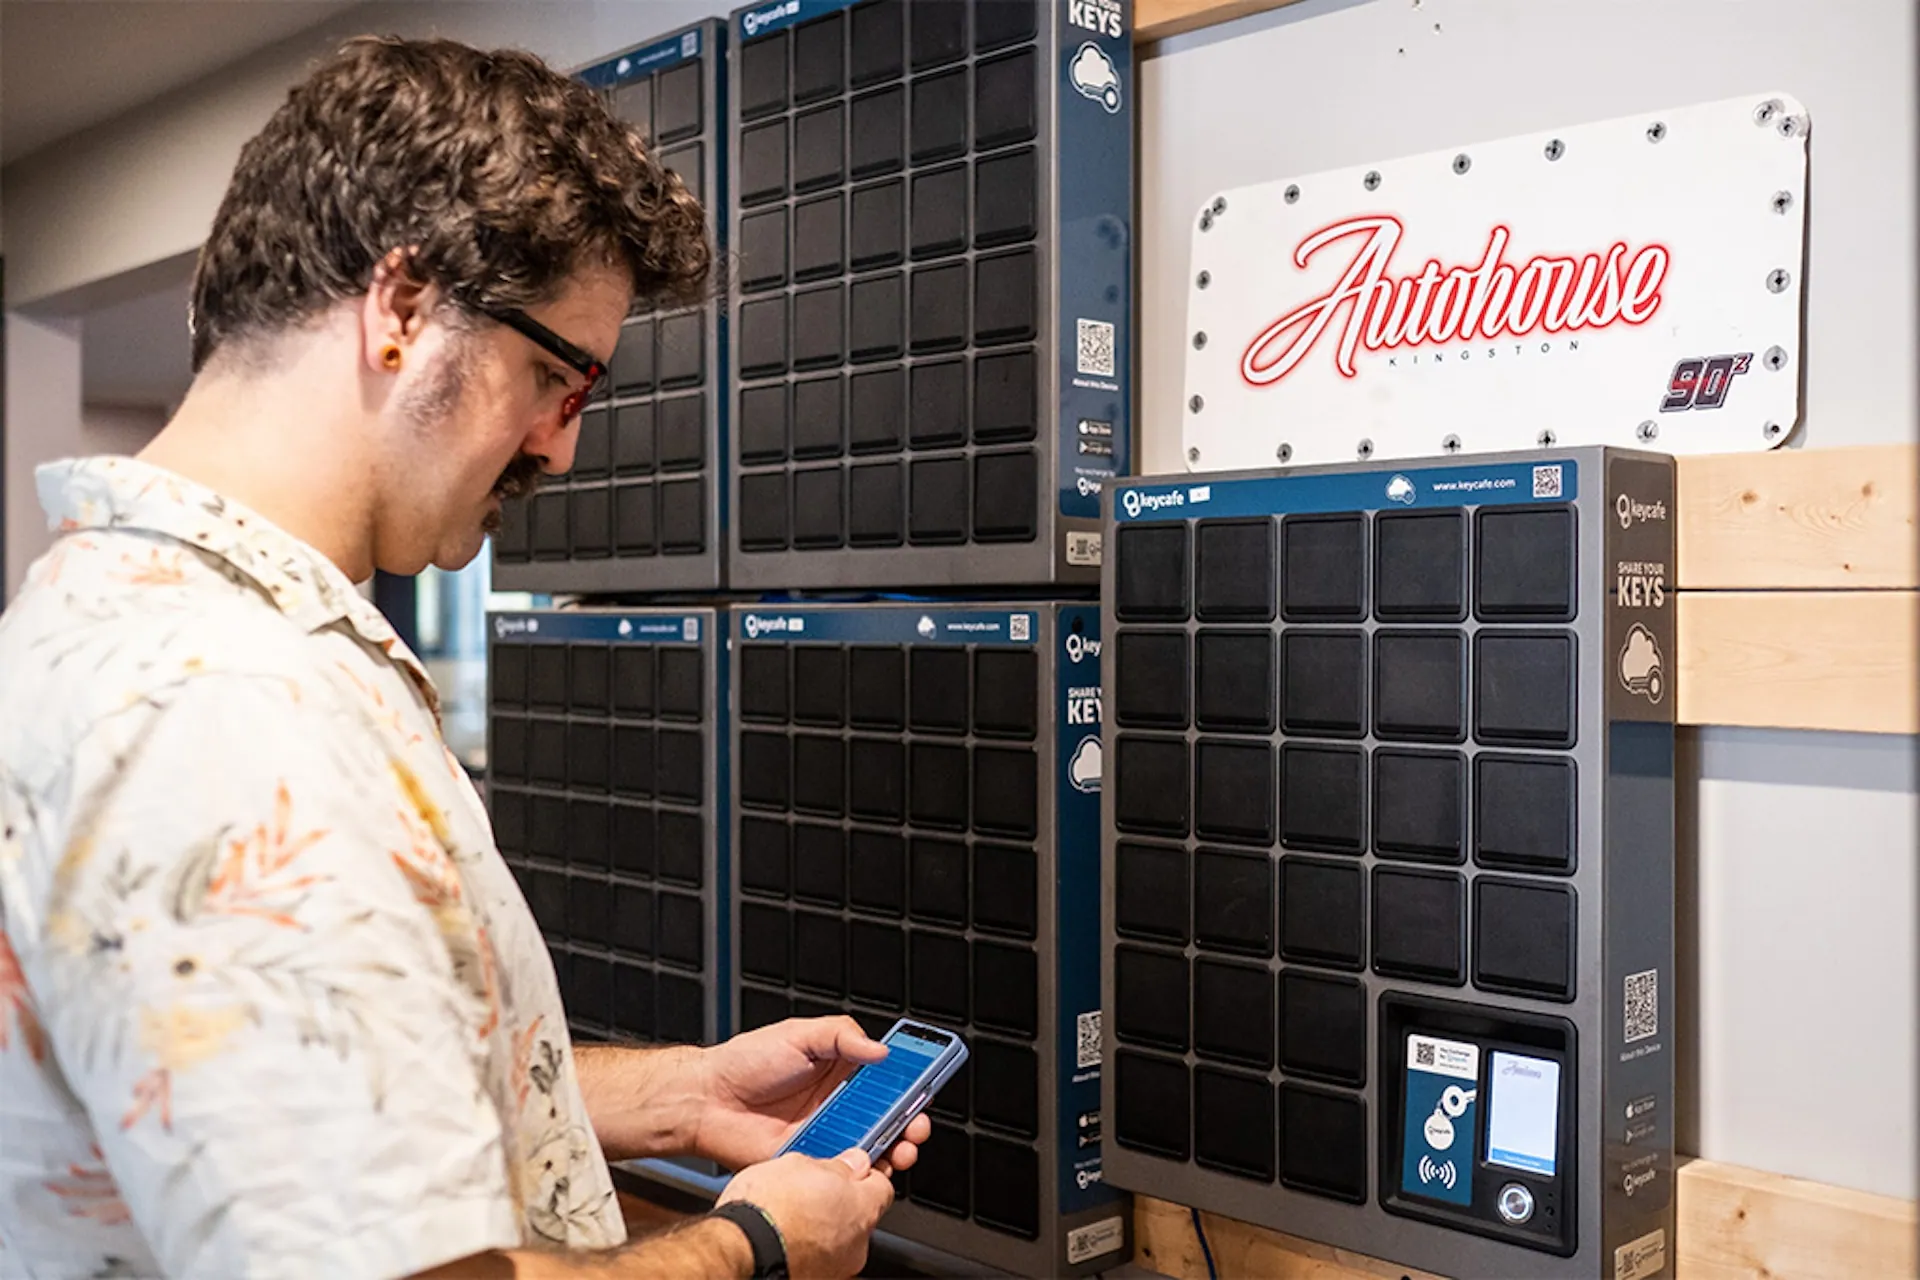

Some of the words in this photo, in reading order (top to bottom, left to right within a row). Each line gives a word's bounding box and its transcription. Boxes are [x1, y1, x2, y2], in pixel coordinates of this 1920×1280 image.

[1068, 0, 1122, 38] KEYS
[1240, 216, 1670, 386] Autohouse
[1388, 340, 1579, 367] KINGSTON
[1433, 478, 1516, 491] www.keycafe.com
[1140, 490, 1184, 511] keycafe
[1631, 499, 1666, 522] keycafe
[1618, 561, 1642, 575] SHARE
[1643, 562, 1664, 575] YOUR
[1617, 576, 1665, 607] KEYS
[1068, 687, 1096, 698] SHARE
